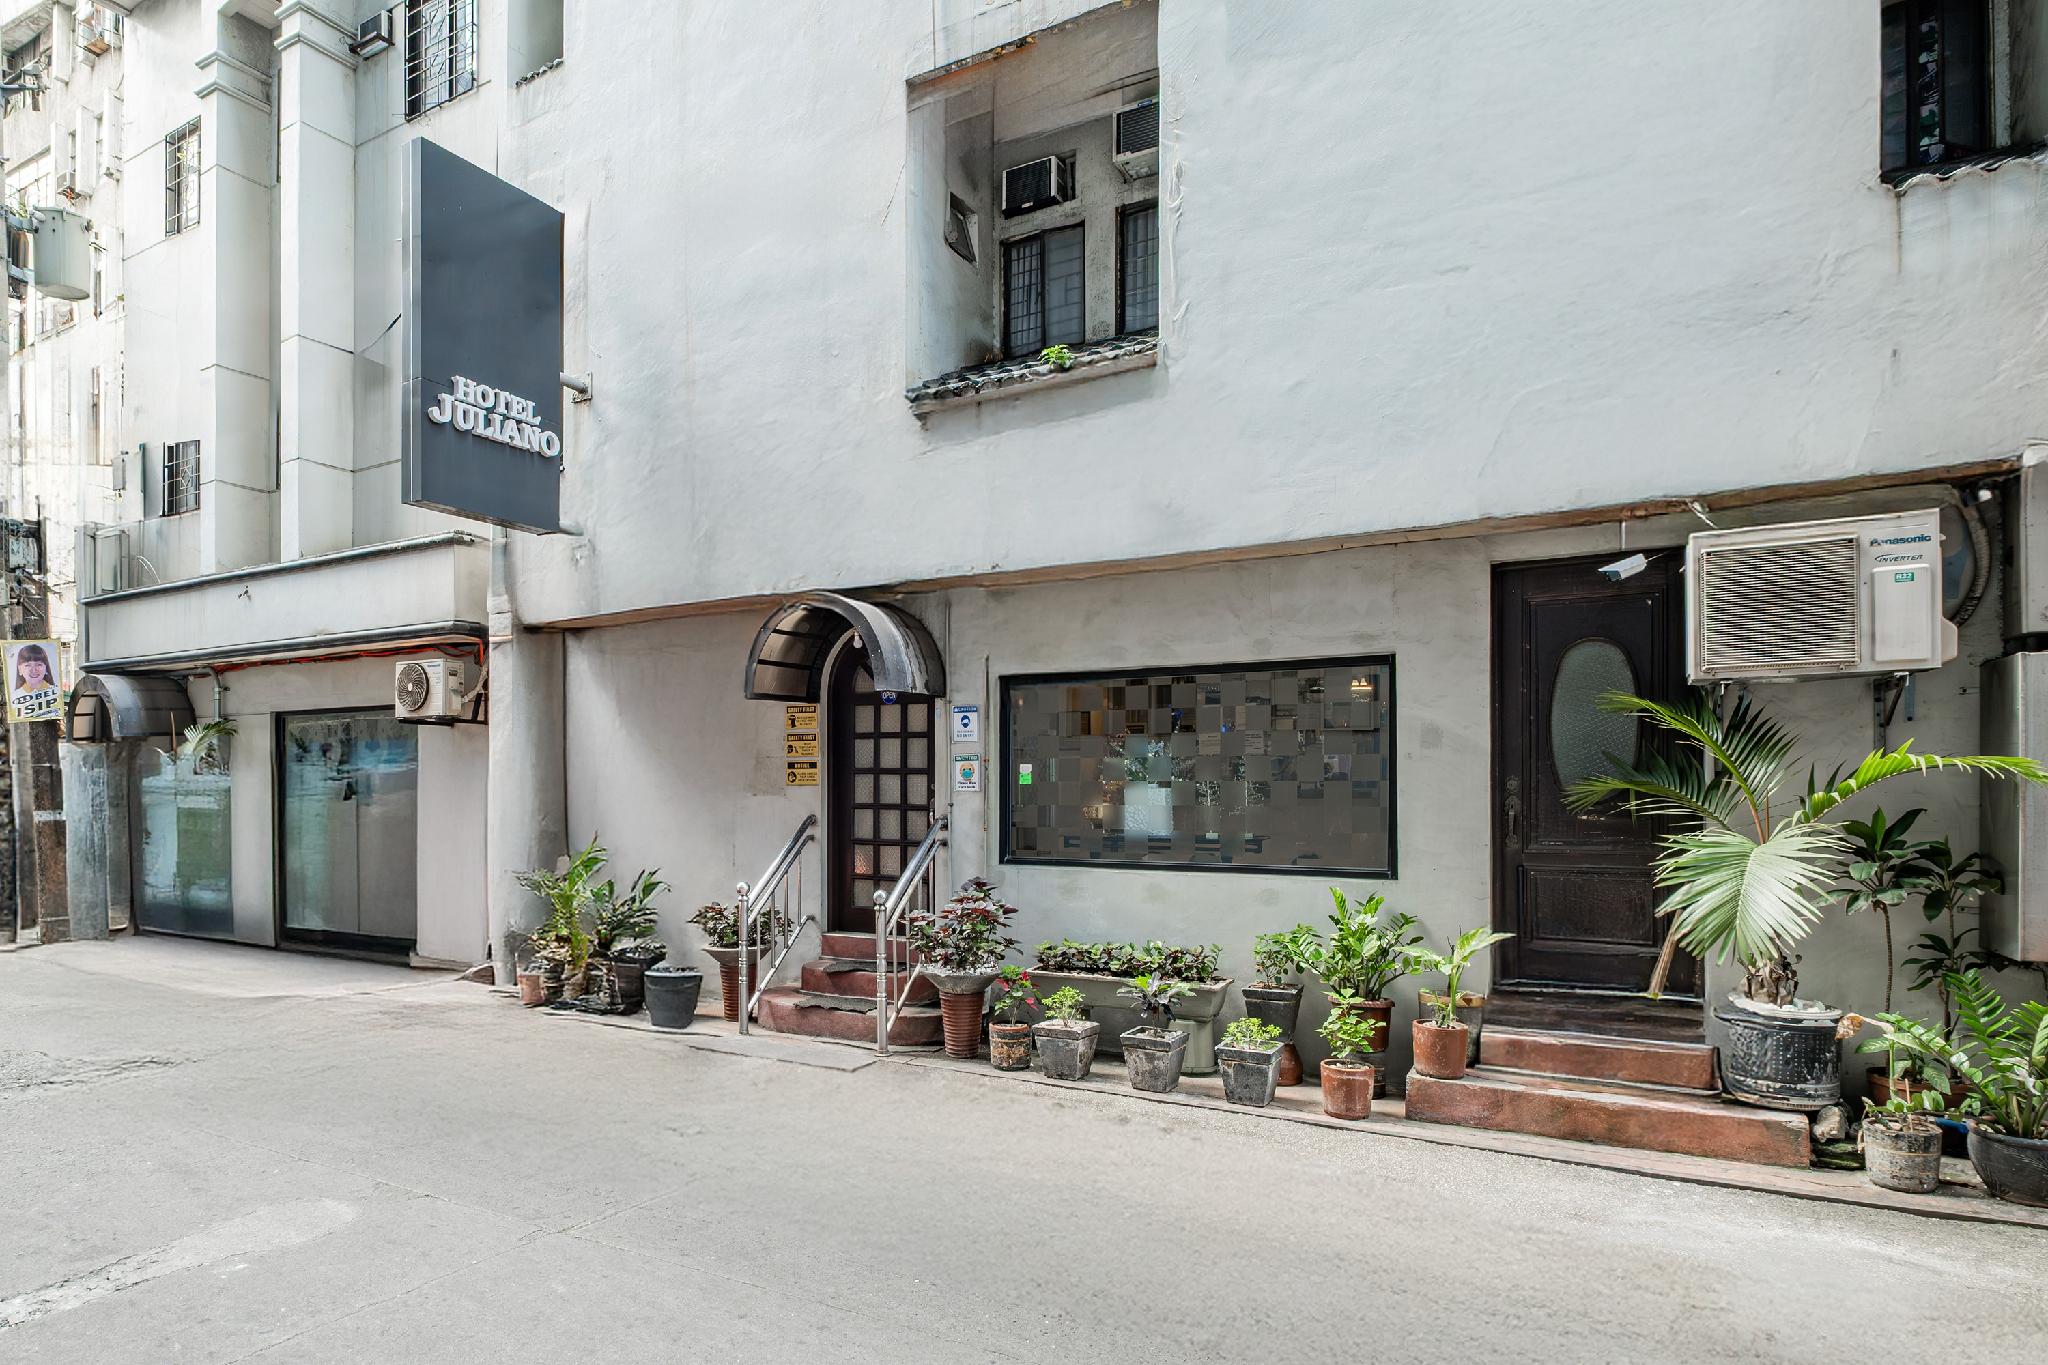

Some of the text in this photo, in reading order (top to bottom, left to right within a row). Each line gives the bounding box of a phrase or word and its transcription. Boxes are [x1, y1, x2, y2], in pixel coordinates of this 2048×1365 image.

[451, 375, 541, 425] HOTEL
[428, 393, 561, 457] JULIANO
[1876, 554, 1923, 562] INVERTER
[35, 689, 57, 700] BEL
[882, 691, 896, 699] OPEN
[17, 698, 57, 717] ISIP
